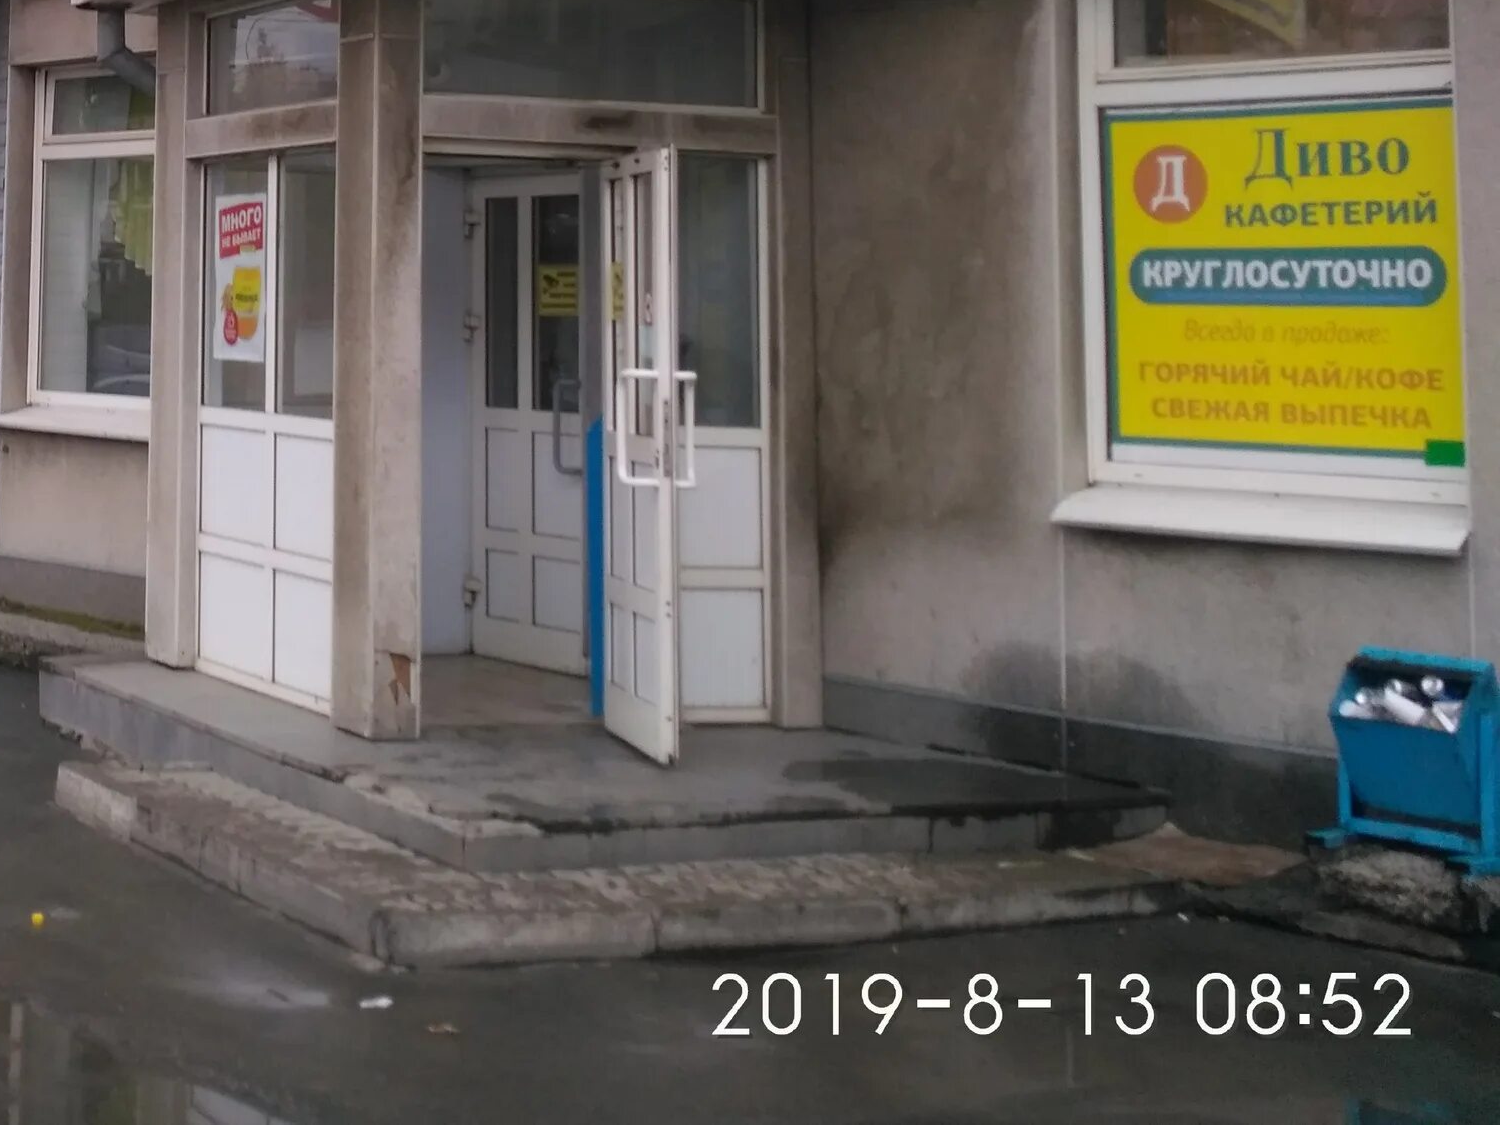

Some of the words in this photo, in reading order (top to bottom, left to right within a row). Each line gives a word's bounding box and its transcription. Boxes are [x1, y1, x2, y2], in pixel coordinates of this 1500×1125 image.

[1151, 154, 1190, 213] Д
[221, 205, 262, 233] МНОГО
[1224, 191, 1438, 228] КАФЕТЕРИЙ
[1142, 258, 1433, 289] КРУГЛОСУТОЧНО
[1183, 318, 1257, 343] Всегда
[1262, 326, 1275, 343] в
[1281, 321, 1389, 349] продаже:
[1138, 357, 1271, 387] ГОРЯЧИЙ
[1280, 359, 1445, 392] ЧАЙ/КОФЕ
[1151, 397, 1271, 424] СВЕЖАЯ
[1280, 402, 1433, 429] ВЫПЕЧКА
